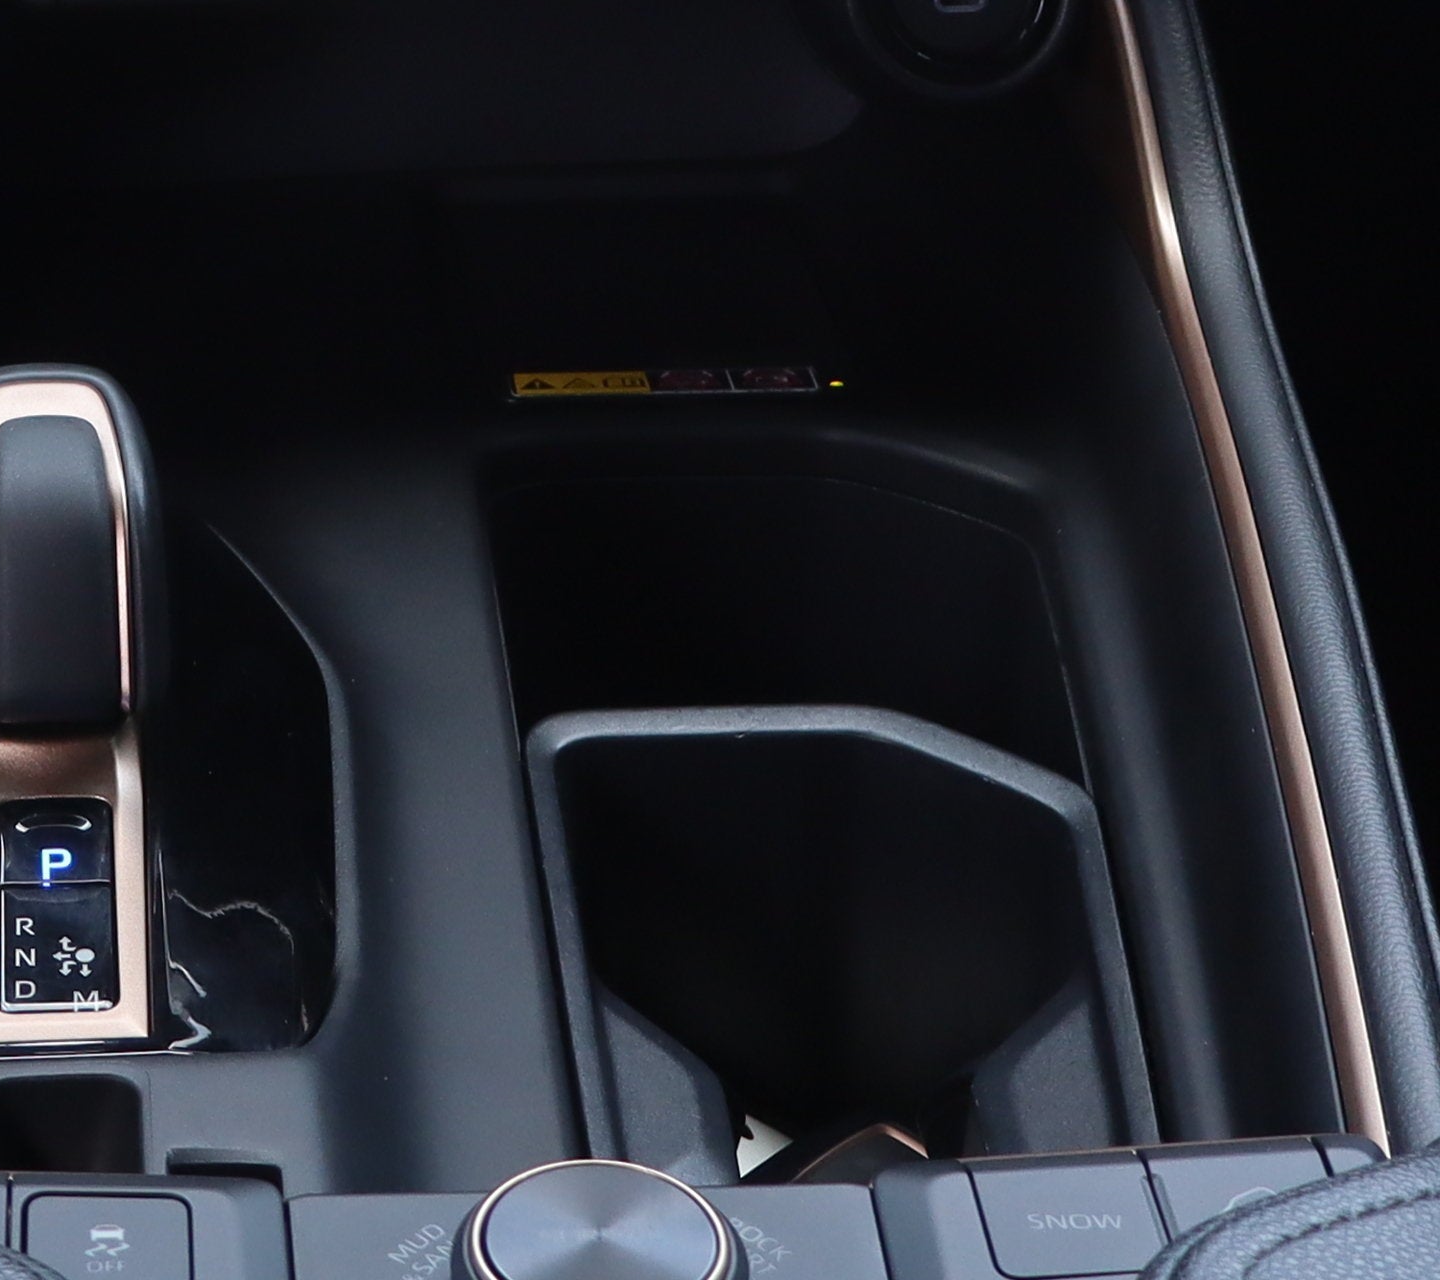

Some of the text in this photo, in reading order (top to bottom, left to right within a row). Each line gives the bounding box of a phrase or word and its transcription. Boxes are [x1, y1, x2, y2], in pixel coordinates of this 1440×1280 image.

[41, 847, 72, 882] P
[15, 917, 36, 936] R
[14, 948, 37, 967] N
[14, 980, 37, 999] D
[72, 990, 100, 1009] M
[1027, 1213, 1123, 1231] SNOW
[387, 1223, 446, 1265] MUD
[86, 1260, 126, 1273] OFF
